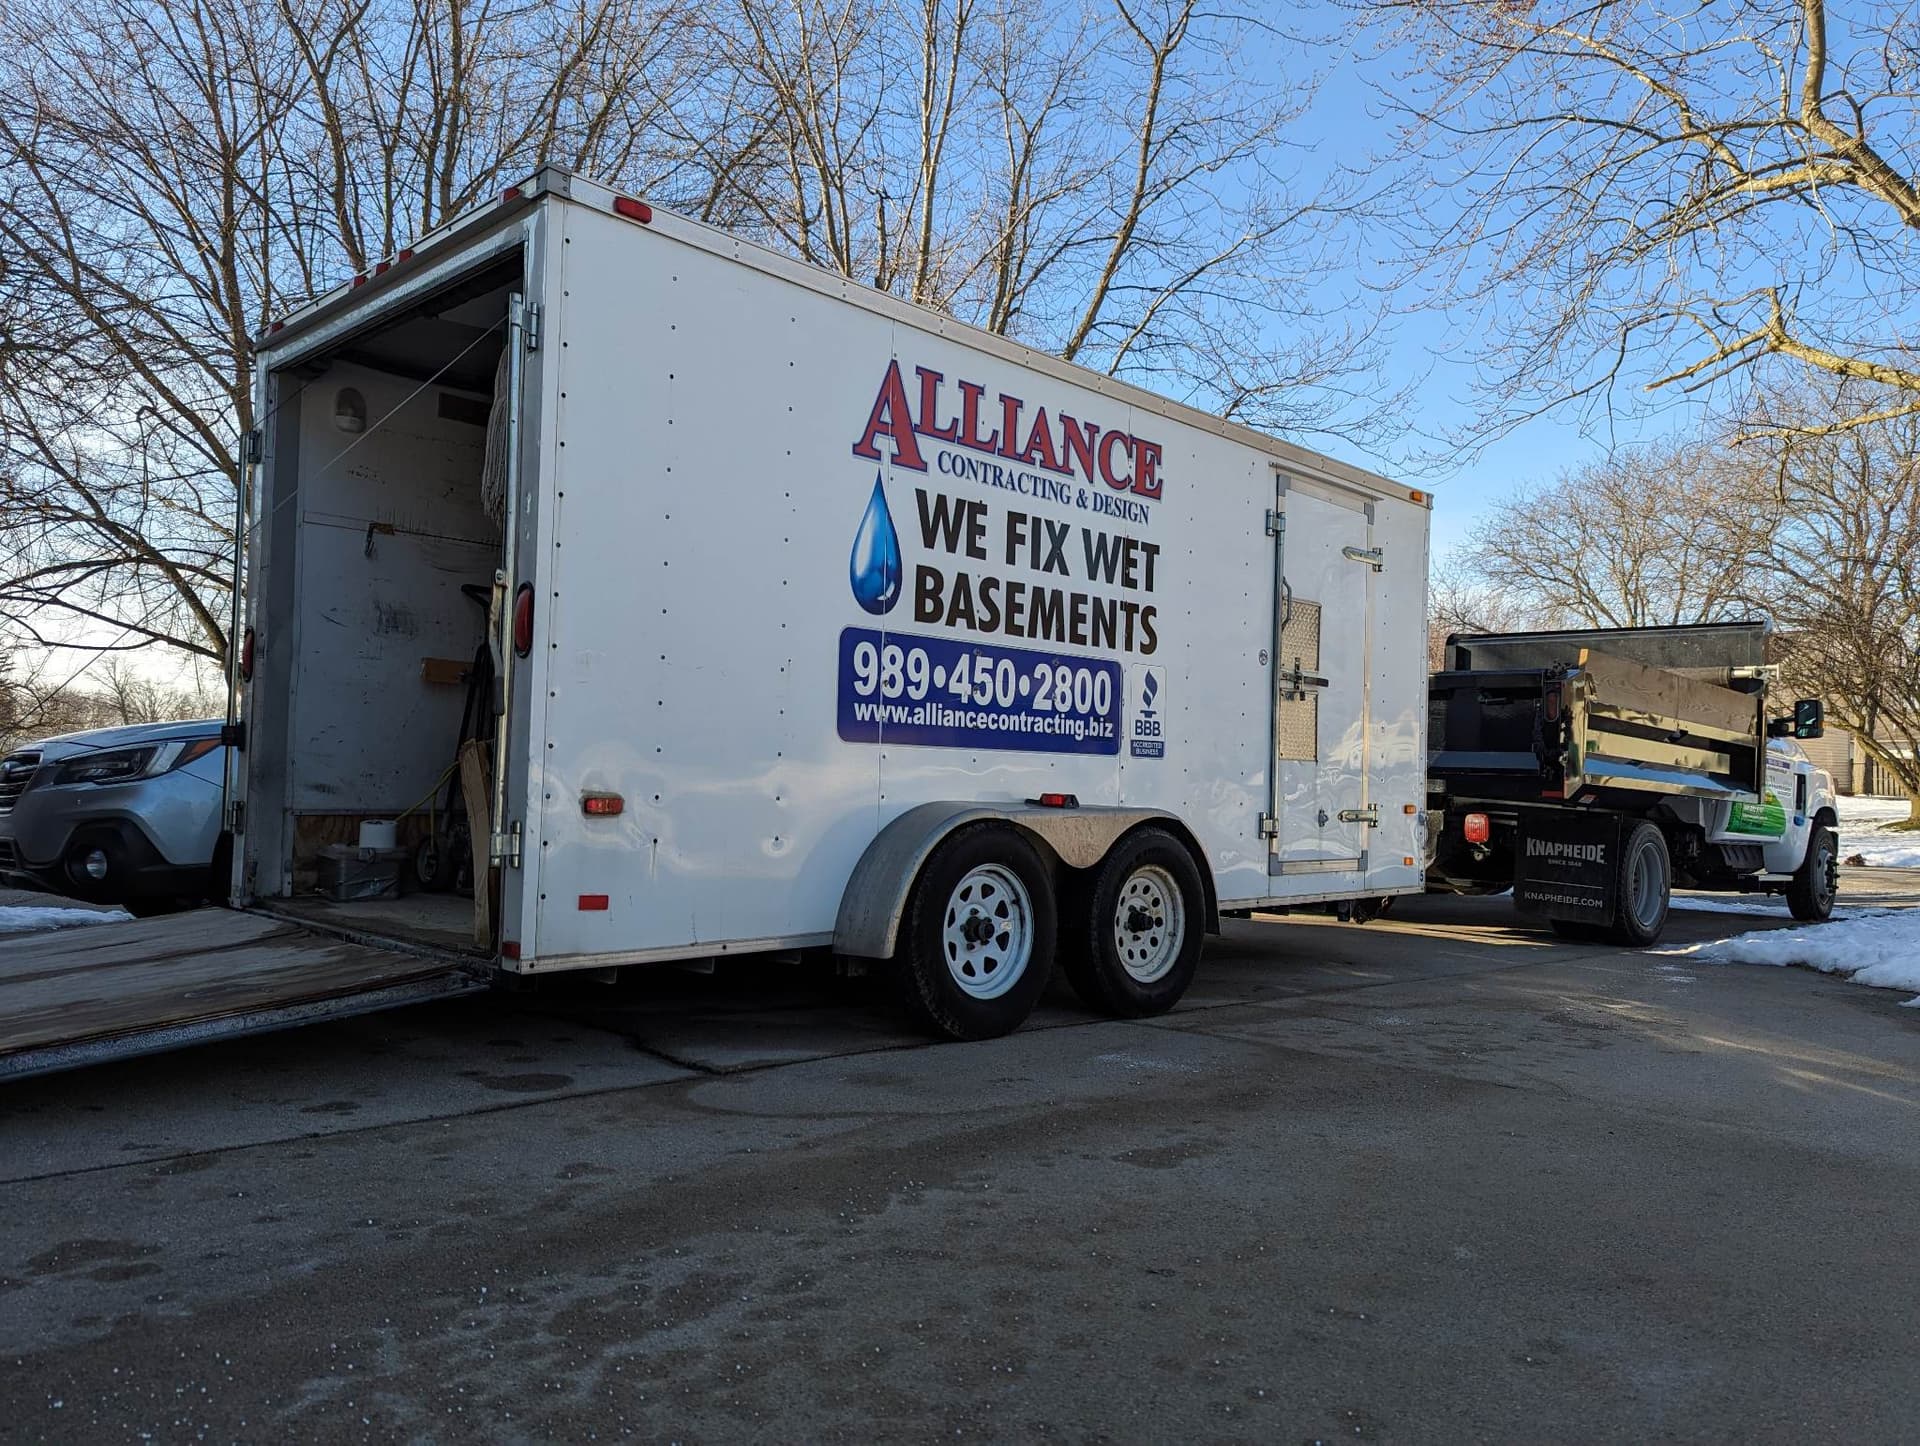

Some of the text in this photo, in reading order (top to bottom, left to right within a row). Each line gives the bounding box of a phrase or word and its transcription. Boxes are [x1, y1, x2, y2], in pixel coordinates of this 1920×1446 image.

[852, 359, 1164, 500] ALLIANCE
[938, 450, 1150, 526] CONTRACTING & DESIGN
[915, 487, 1161, 593] WE FIX WET
[914, 564, 1159, 655] BASEMENTS
[854, 701, 1114, 741] www.alliancecontracting.biz
[1135, 719, 1161, 736] BBB
[1526, 837, 1606, 865] KNAPHEIDE
[1524, 891, 1603, 908] KNAPHEIDE.COM
